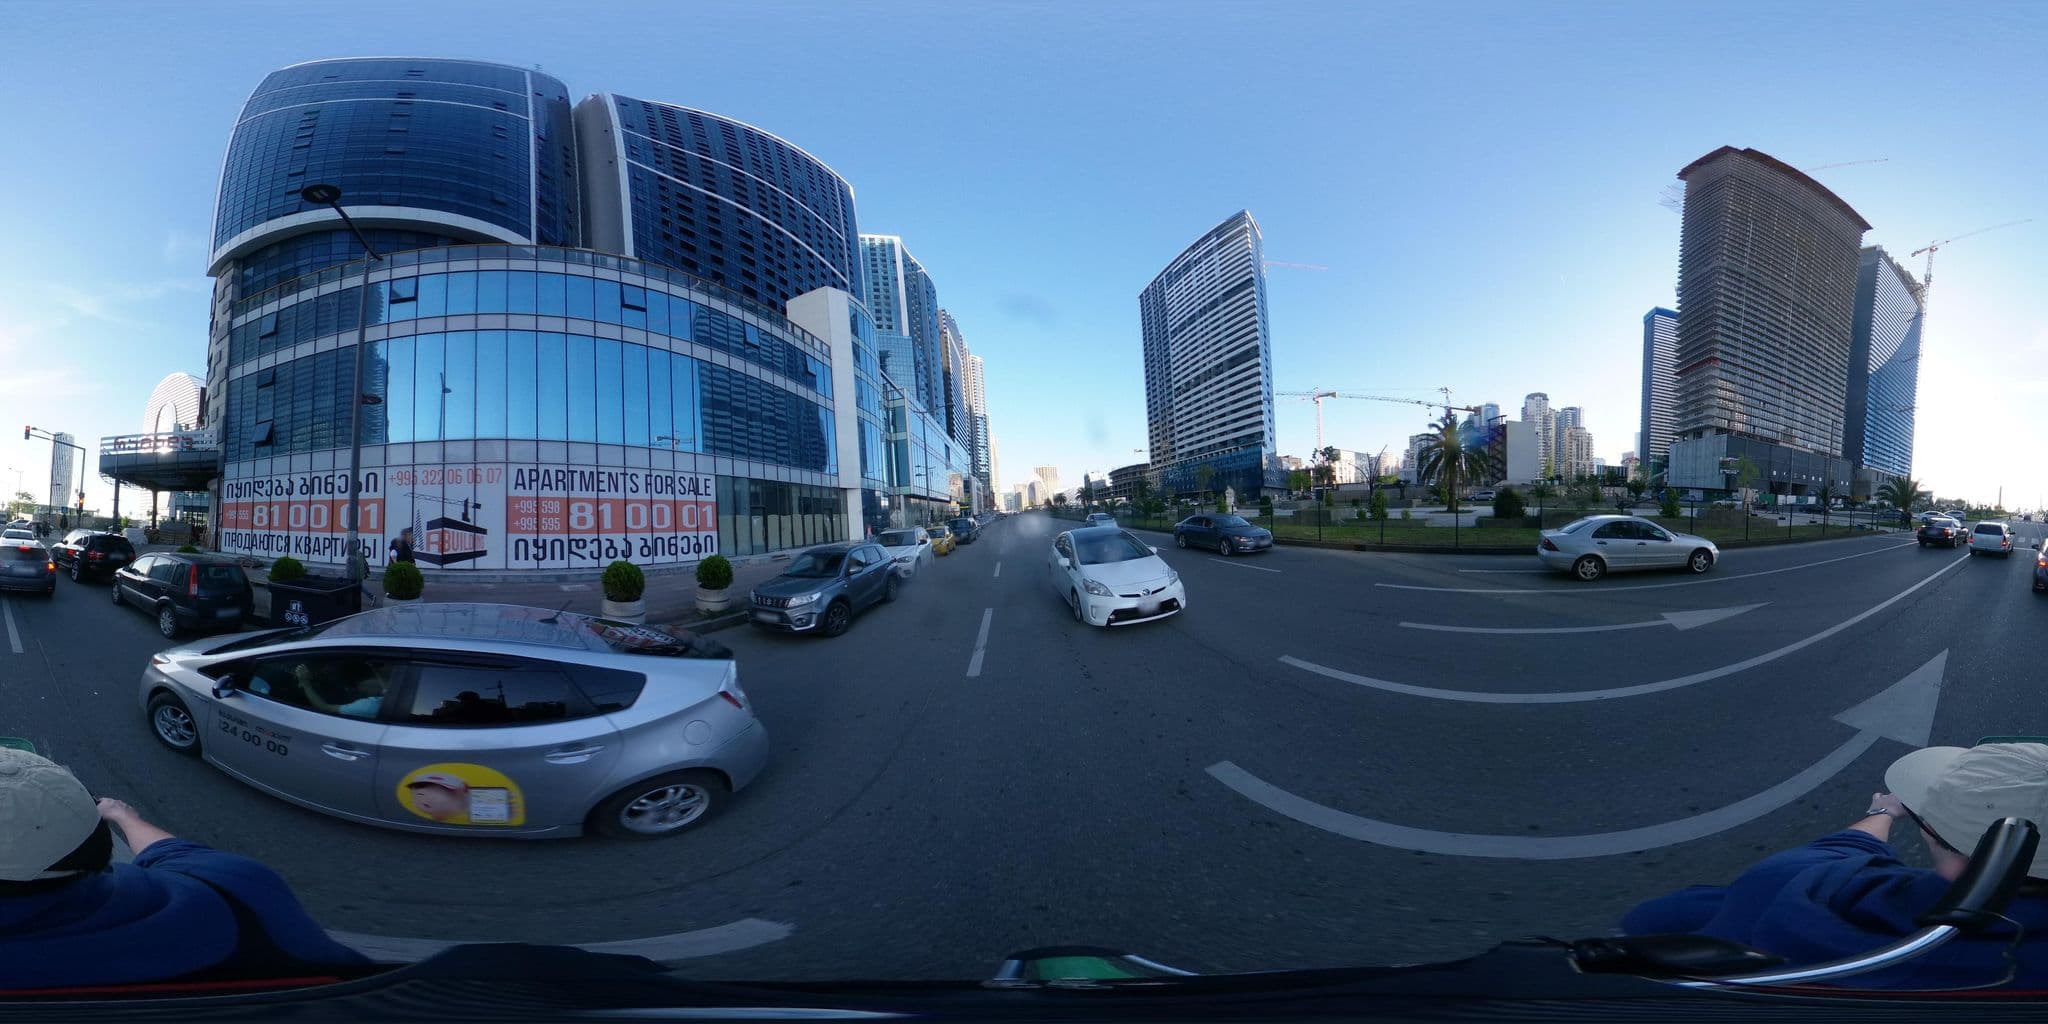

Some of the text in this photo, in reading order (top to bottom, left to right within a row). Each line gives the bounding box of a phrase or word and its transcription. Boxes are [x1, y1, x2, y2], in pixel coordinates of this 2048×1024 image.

[226, 478, 294, 498] იყიდება
[389, 467, 502, 486] +995 322 06 06 07
[514, 468, 711, 496] APARTMENTS FOR SALE
[253, 505, 280, 527] 81
[289, 504, 328, 529] 00
[512, 500, 560, 514] +995 598
[569, 502, 713, 530] 81 00 01
[513, 517, 560, 531] +995 595
[224, 531, 290, 554] ПРОДАЮТСЯ
[514, 534, 714, 561] იყიდება ბინები
[242, 730, 261, 746] 00
[266, 740, 288, 756] 00
